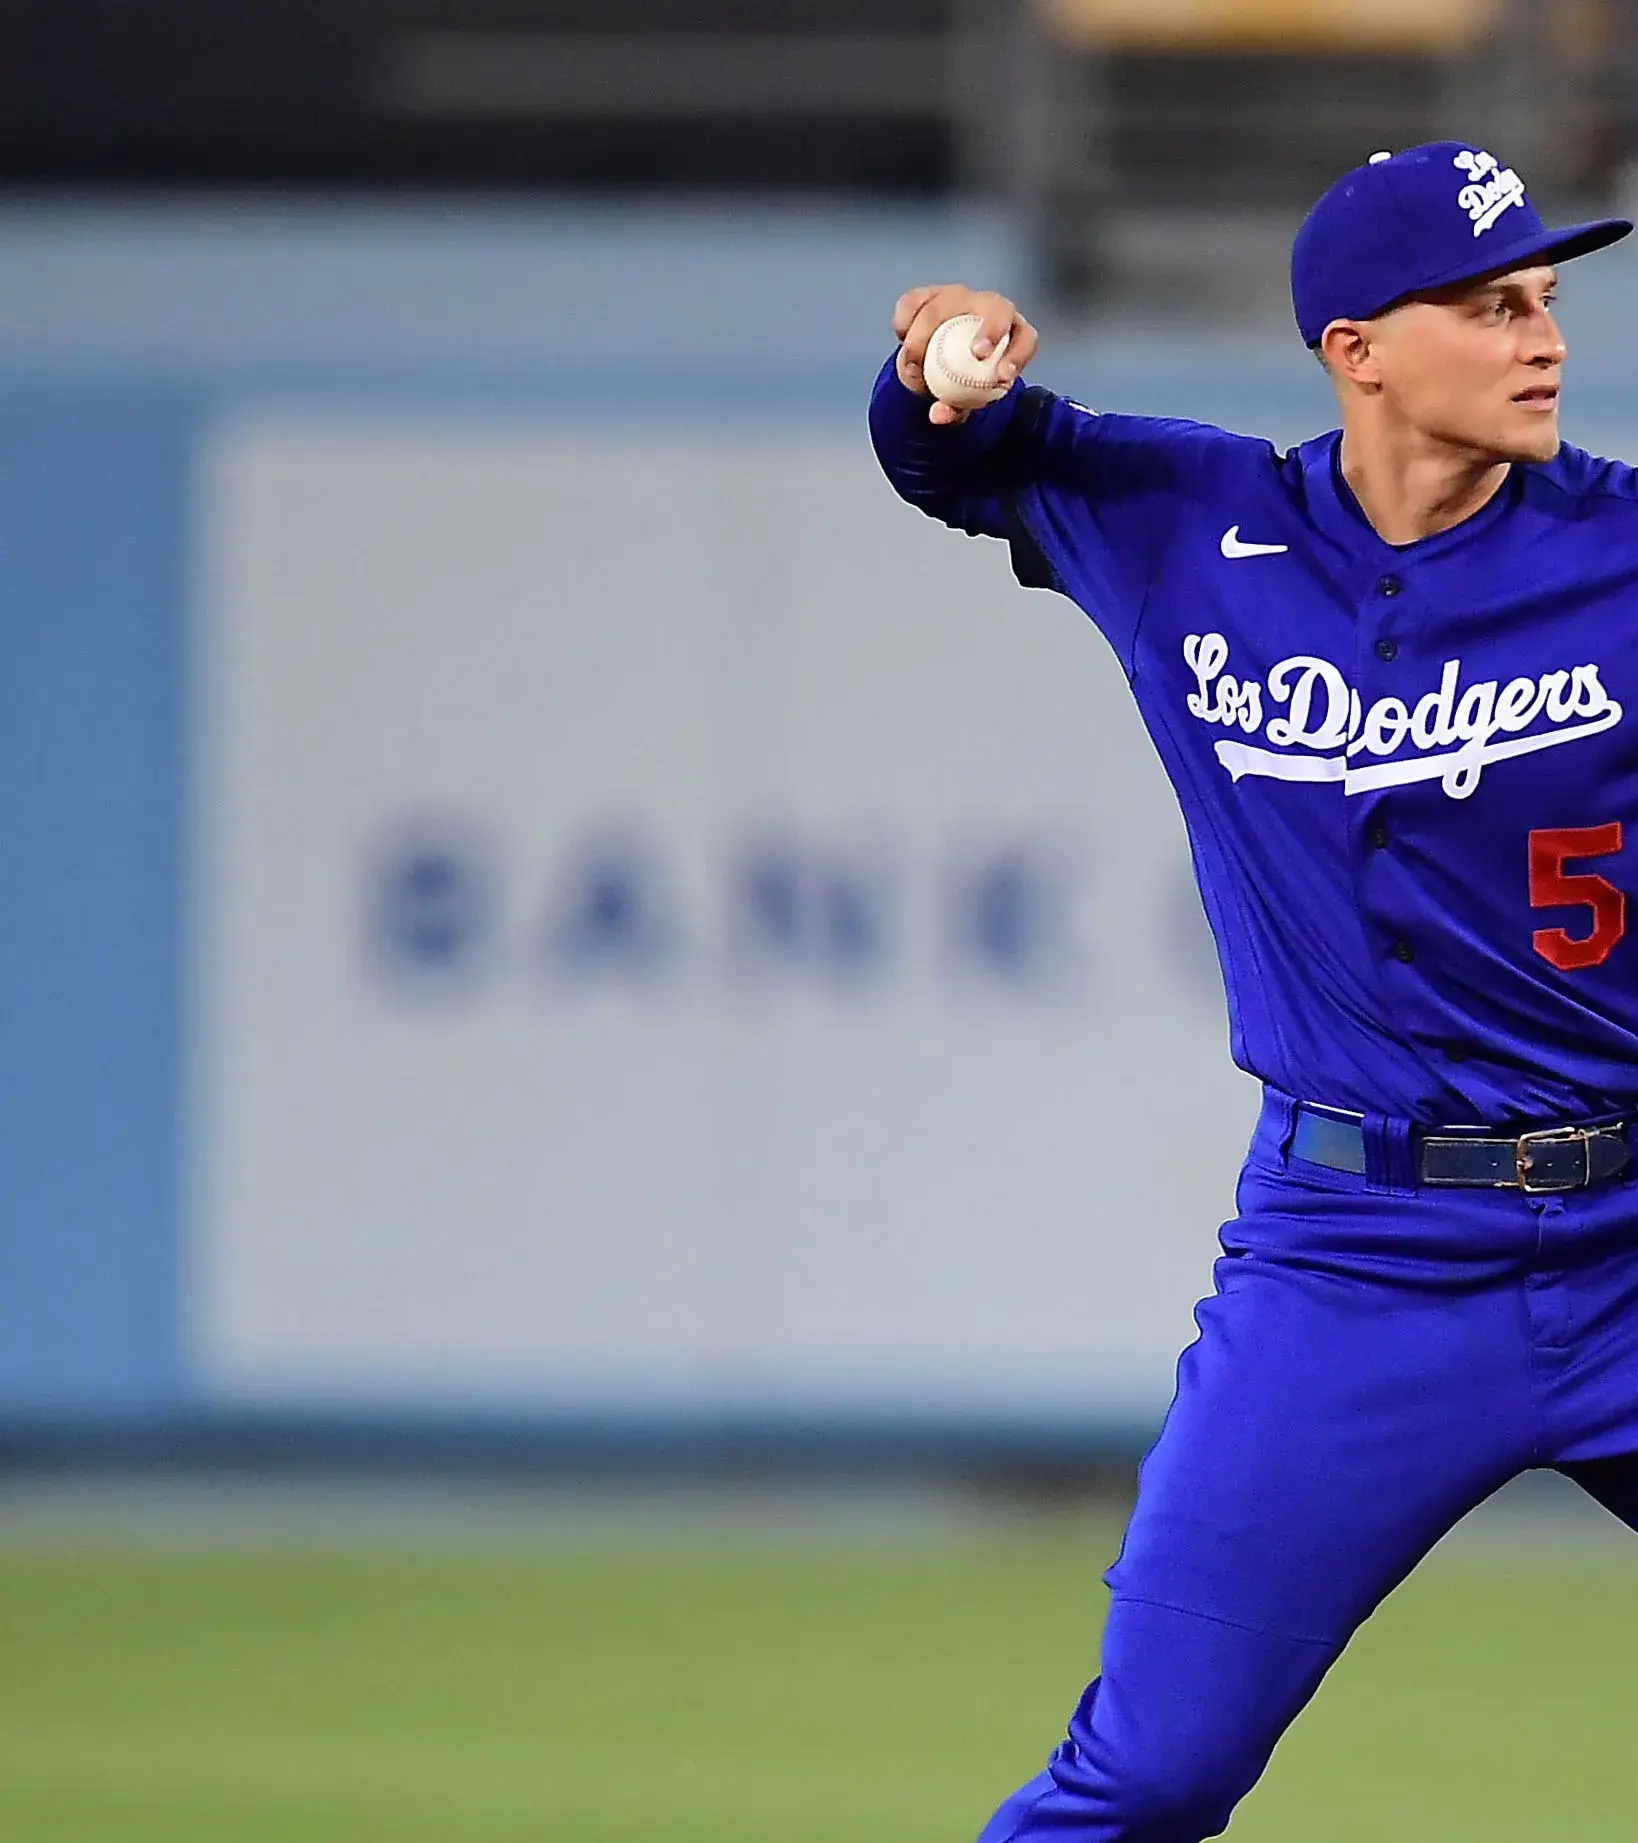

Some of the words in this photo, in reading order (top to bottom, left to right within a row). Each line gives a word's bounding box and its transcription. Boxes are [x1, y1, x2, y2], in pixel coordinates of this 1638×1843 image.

[1183, 632, 1263, 733] Los
[1266, 652, 1623, 800] Dodgers
[1527, 820, 1626, 972] 5
